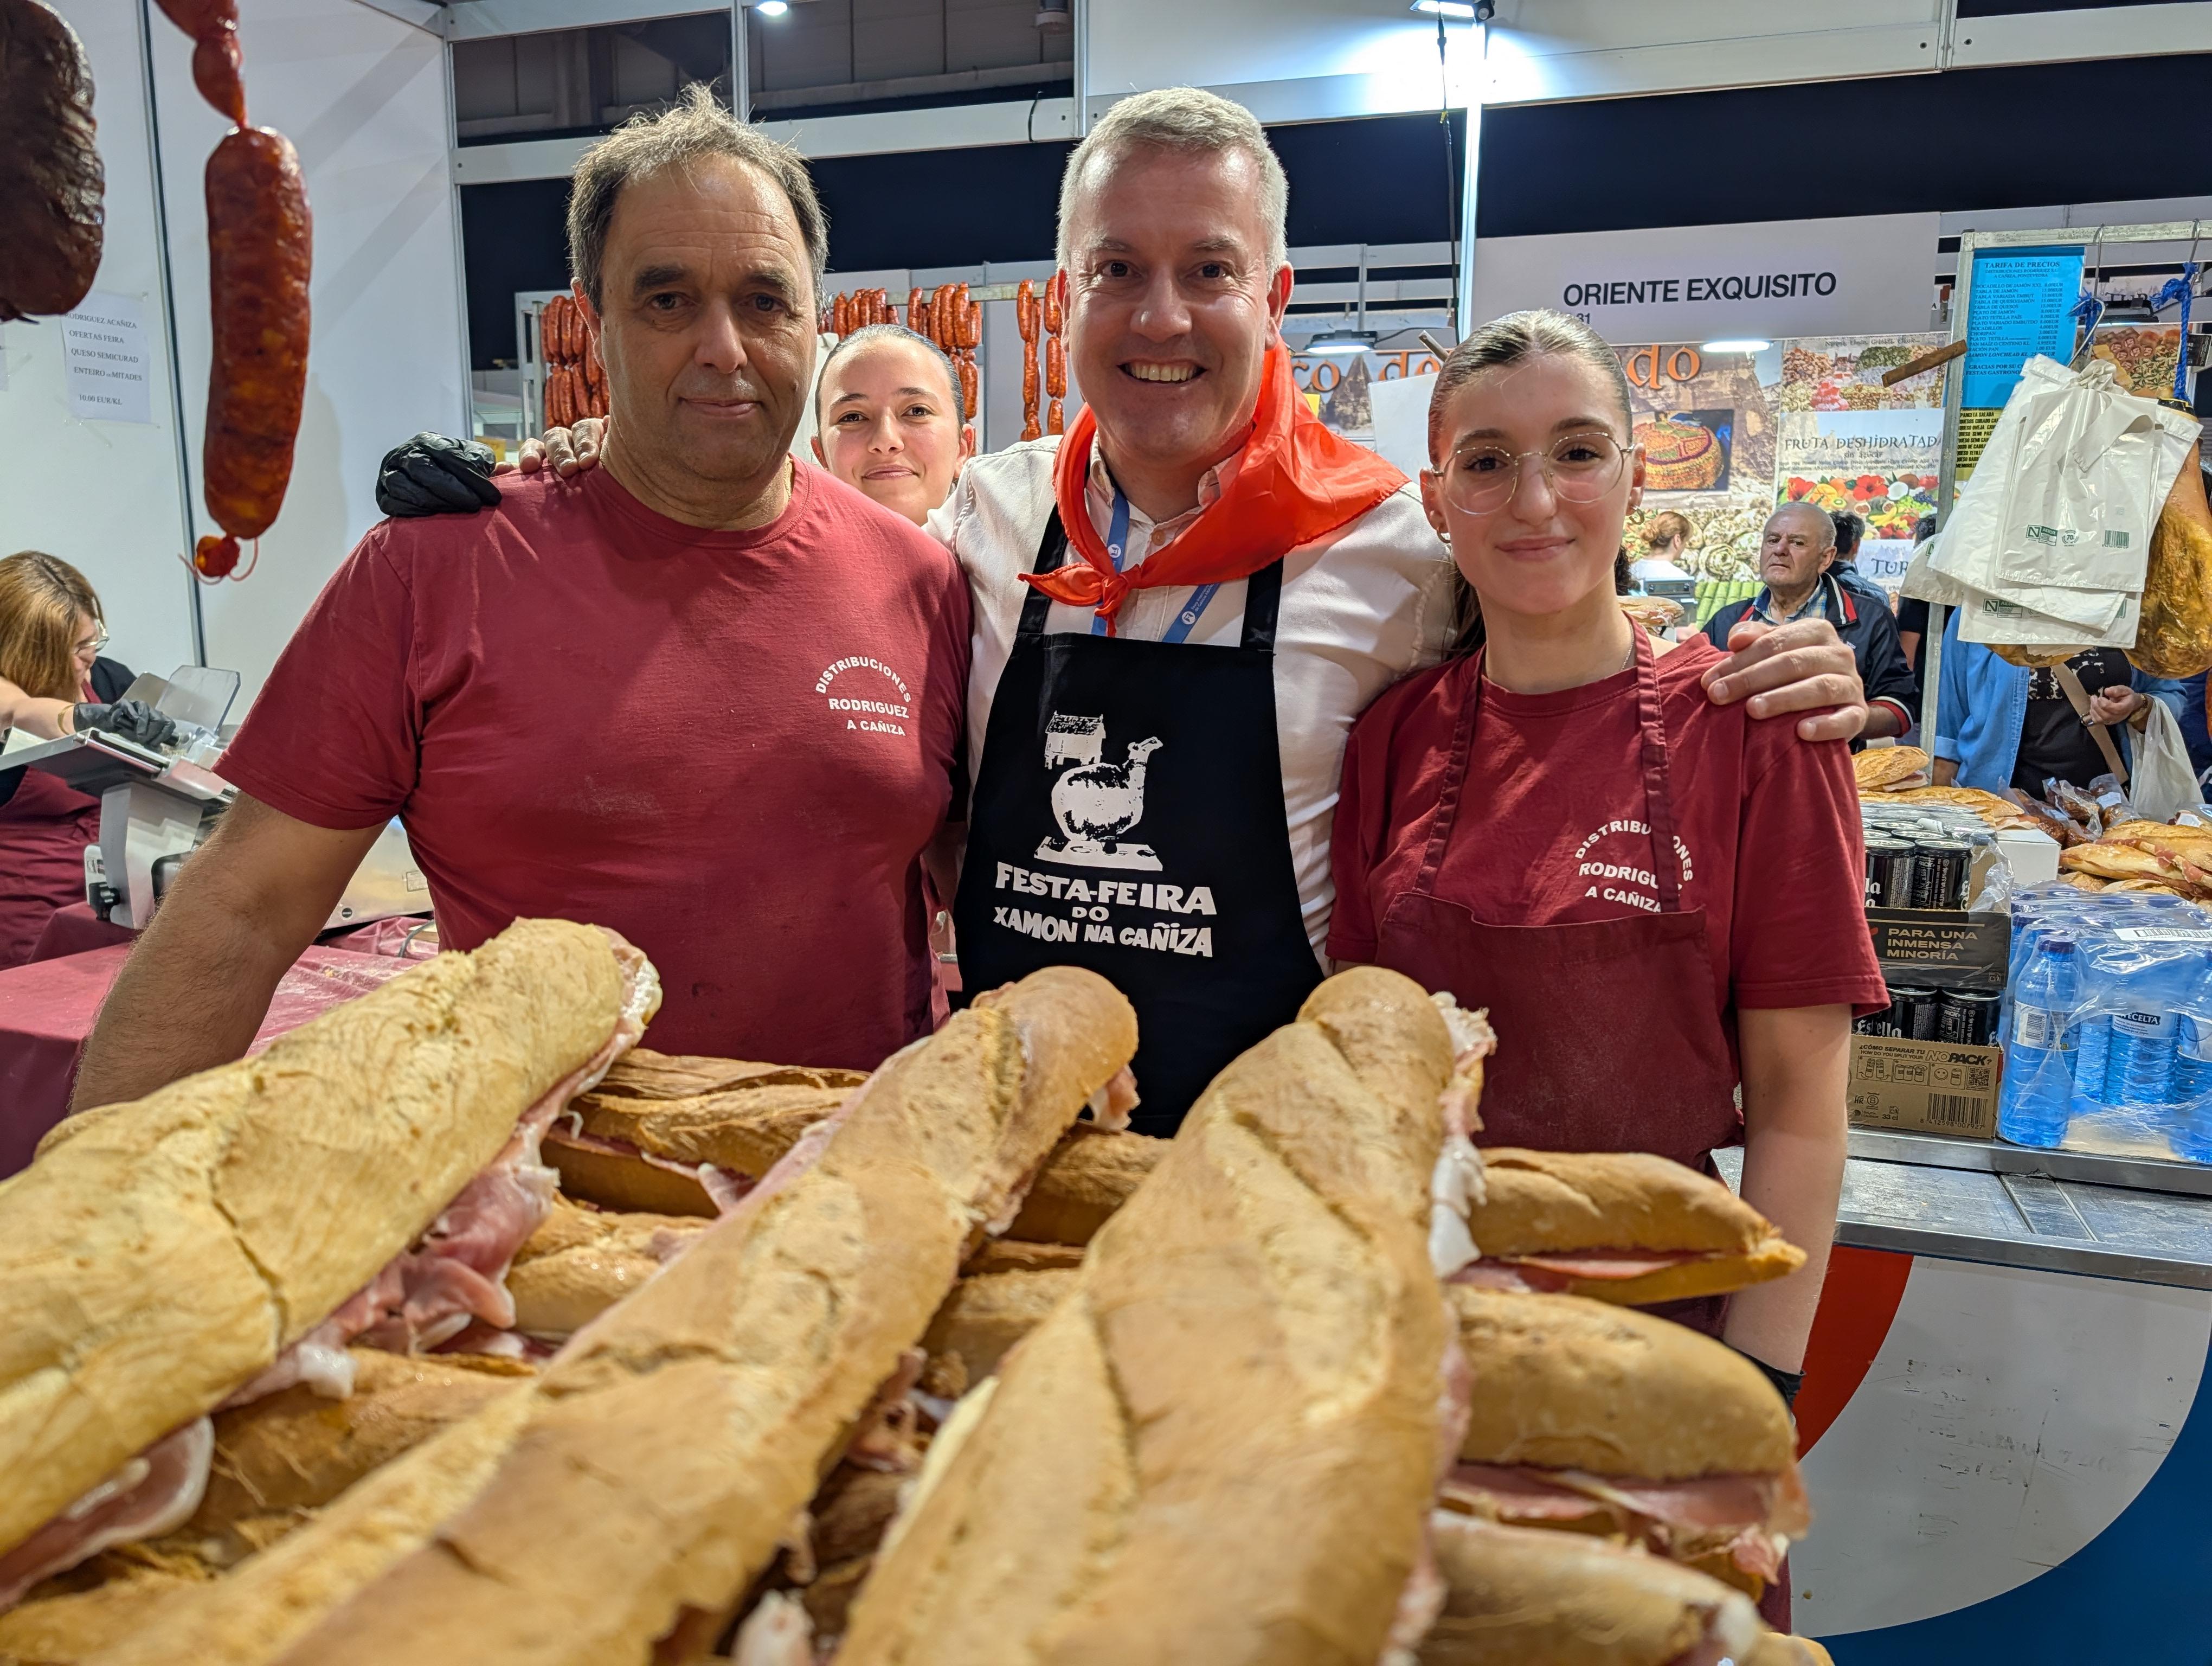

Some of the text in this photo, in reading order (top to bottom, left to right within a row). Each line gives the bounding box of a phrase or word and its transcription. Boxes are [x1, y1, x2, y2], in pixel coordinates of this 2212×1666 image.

[1564, 272, 1836, 306] ORIENTE EXQUISITO
[69, 329, 125, 344] OFERTAS FEIRA
[71, 347, 97, 358] QUESO
[74, 366, 106, 377] ENTEIRO
[1785, 436, 1829, 451] FRUTA
[815, 656, 911, 703] DISTRIBUCIONES
[828, 698, 910, 719] RODRIGUEZ
[847, 720, 906, 736] A CAÑIZA
[1574, 819, 1693, 881] DISTRIBUONES
[995, 861, 1217, 915] FESTA-FEIRA
[1585, 886, 1661, 913] A CAÑIZA
[1072, 906, 1110, 921] DO
[993, 907, 1078, 943] XAMON
[1084, 925, 1115, 944] NA
[1888, 928, 1978, 940] PARA UNA
[1888, 939, 1964, 950] INMENSA
[1887, 950, 1959, 960] MINORÍA
[1885, 1046, 1915, 1054] SEPARAR
